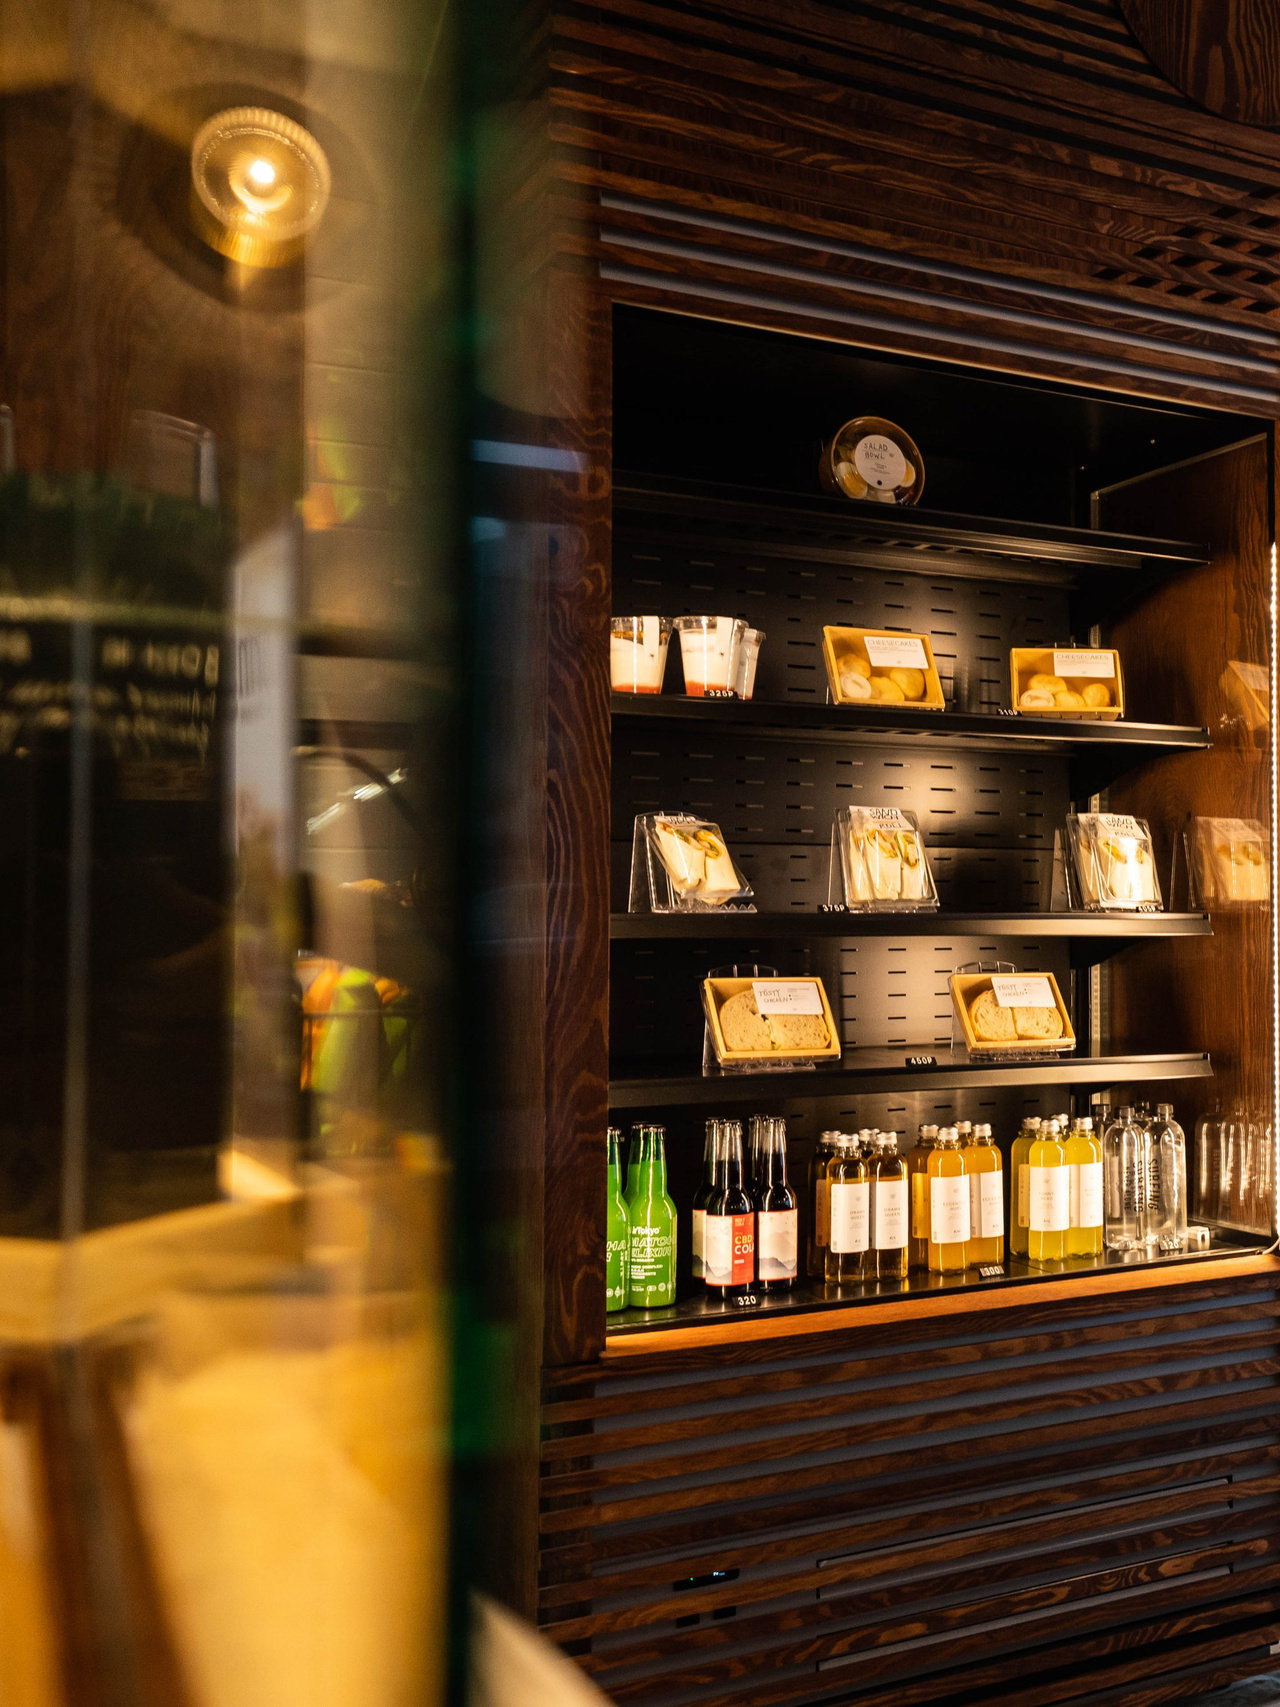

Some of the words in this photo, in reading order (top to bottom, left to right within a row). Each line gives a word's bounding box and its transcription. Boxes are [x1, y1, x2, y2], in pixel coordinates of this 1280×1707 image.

[863, 442, 889, 452] SALAD
[864, 451, 886, 460] BOWL
[867, 639, 919, 648] CHEESECAKES
[1056, 652, 1110, 661] CHEESECAKES
[1147, 1158, 1161, 1211] SURFING
[632, 1225, 660, 1237] irTokyo
[734, 1234, 752, 1245] CBD
[984, 1265, 1001, 1276] 300
[737, 1295, 757, 1306] 320
